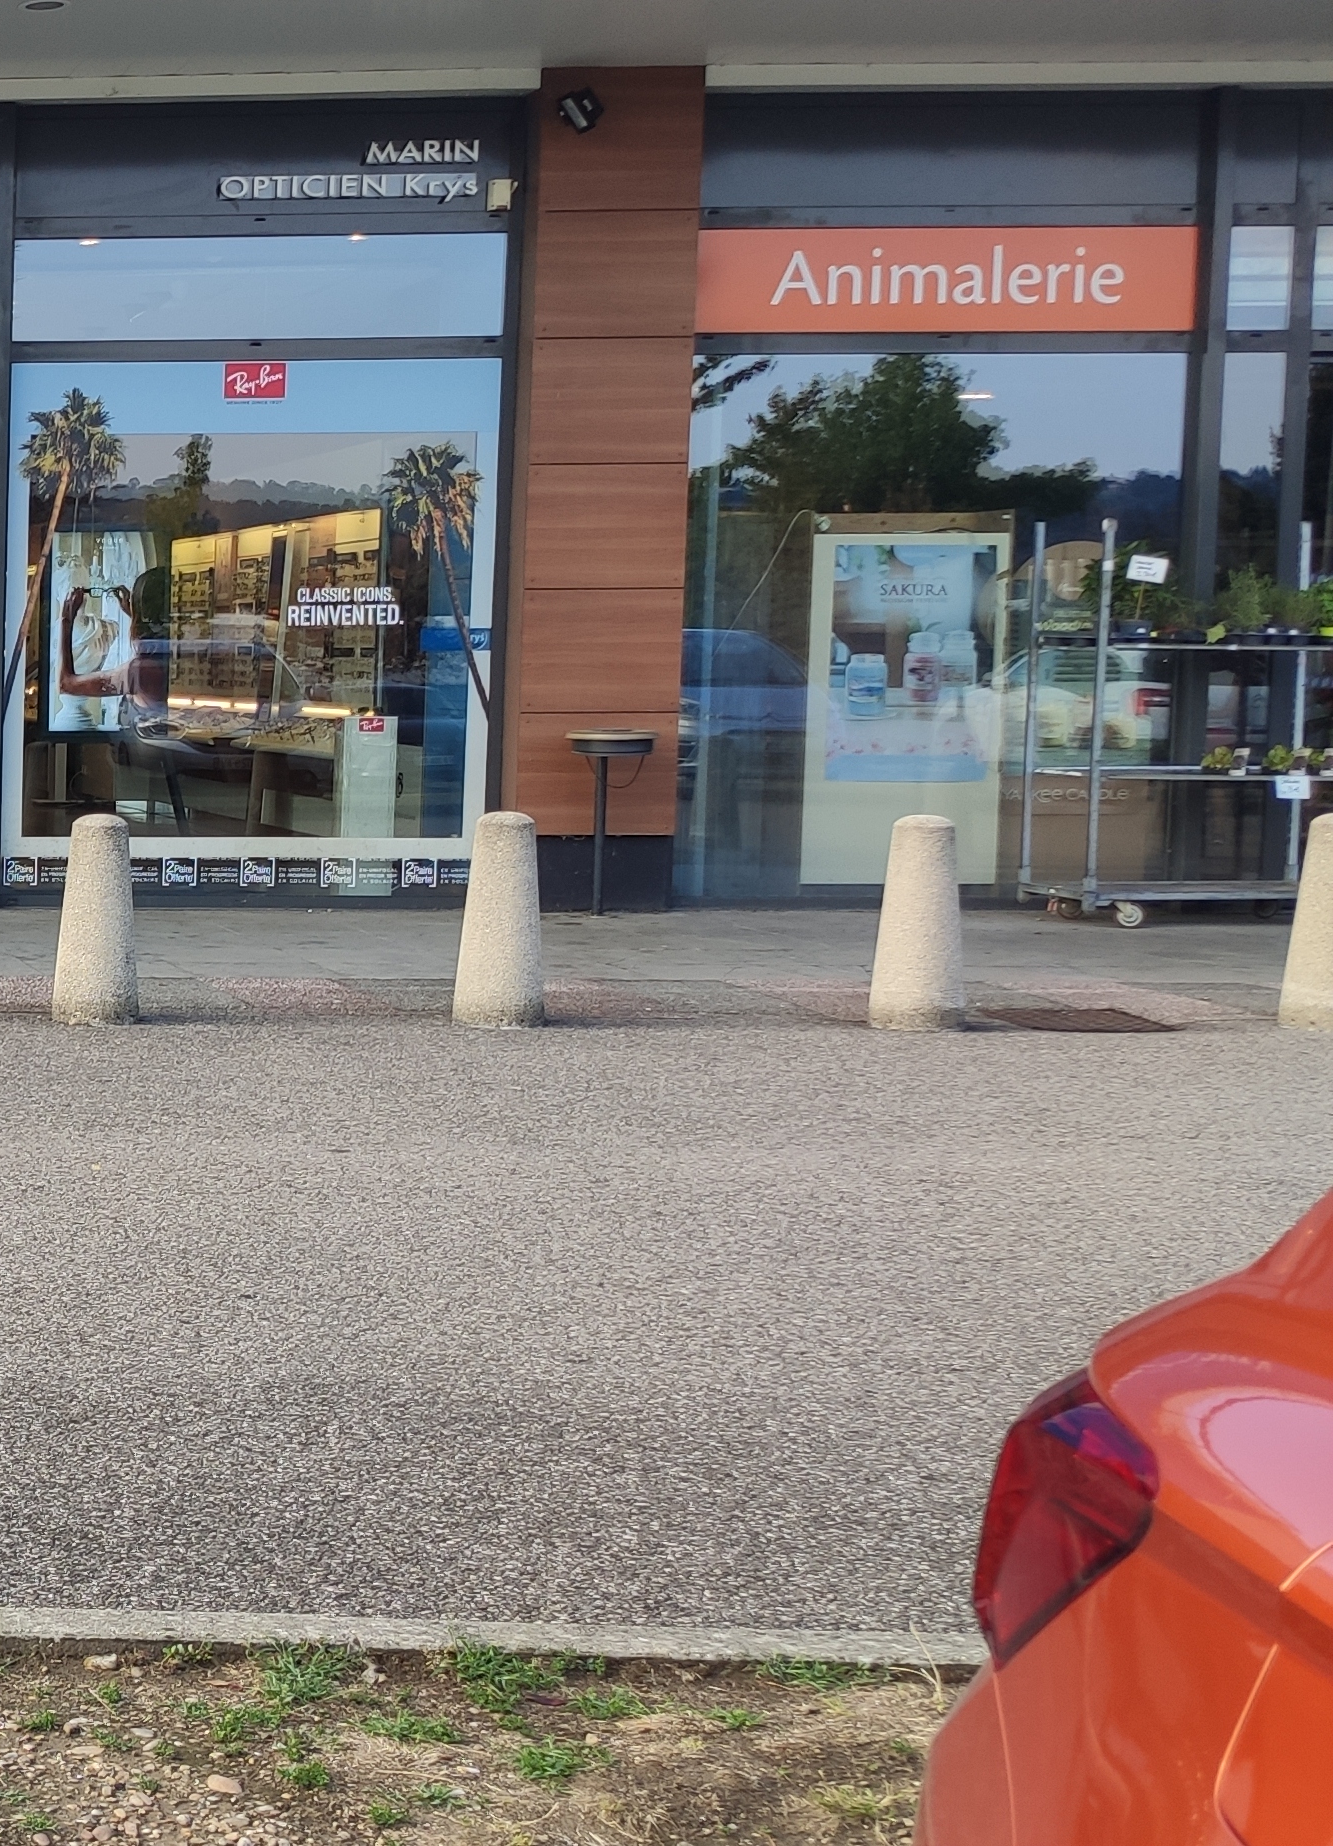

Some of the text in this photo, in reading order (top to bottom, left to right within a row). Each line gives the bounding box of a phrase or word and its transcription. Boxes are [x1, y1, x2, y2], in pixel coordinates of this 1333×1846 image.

[364, 138, 480, 165] MARIN
[219, 173, 478, 203] OPTICIEN Krys
[770, 244, 1125, 306] Animalerie
[297, 586, 396, 603] CLASSIC ICONS.
[879, 583, 948, 596] SAKURA
[287, 604, 404, 627] REINVENTED.
